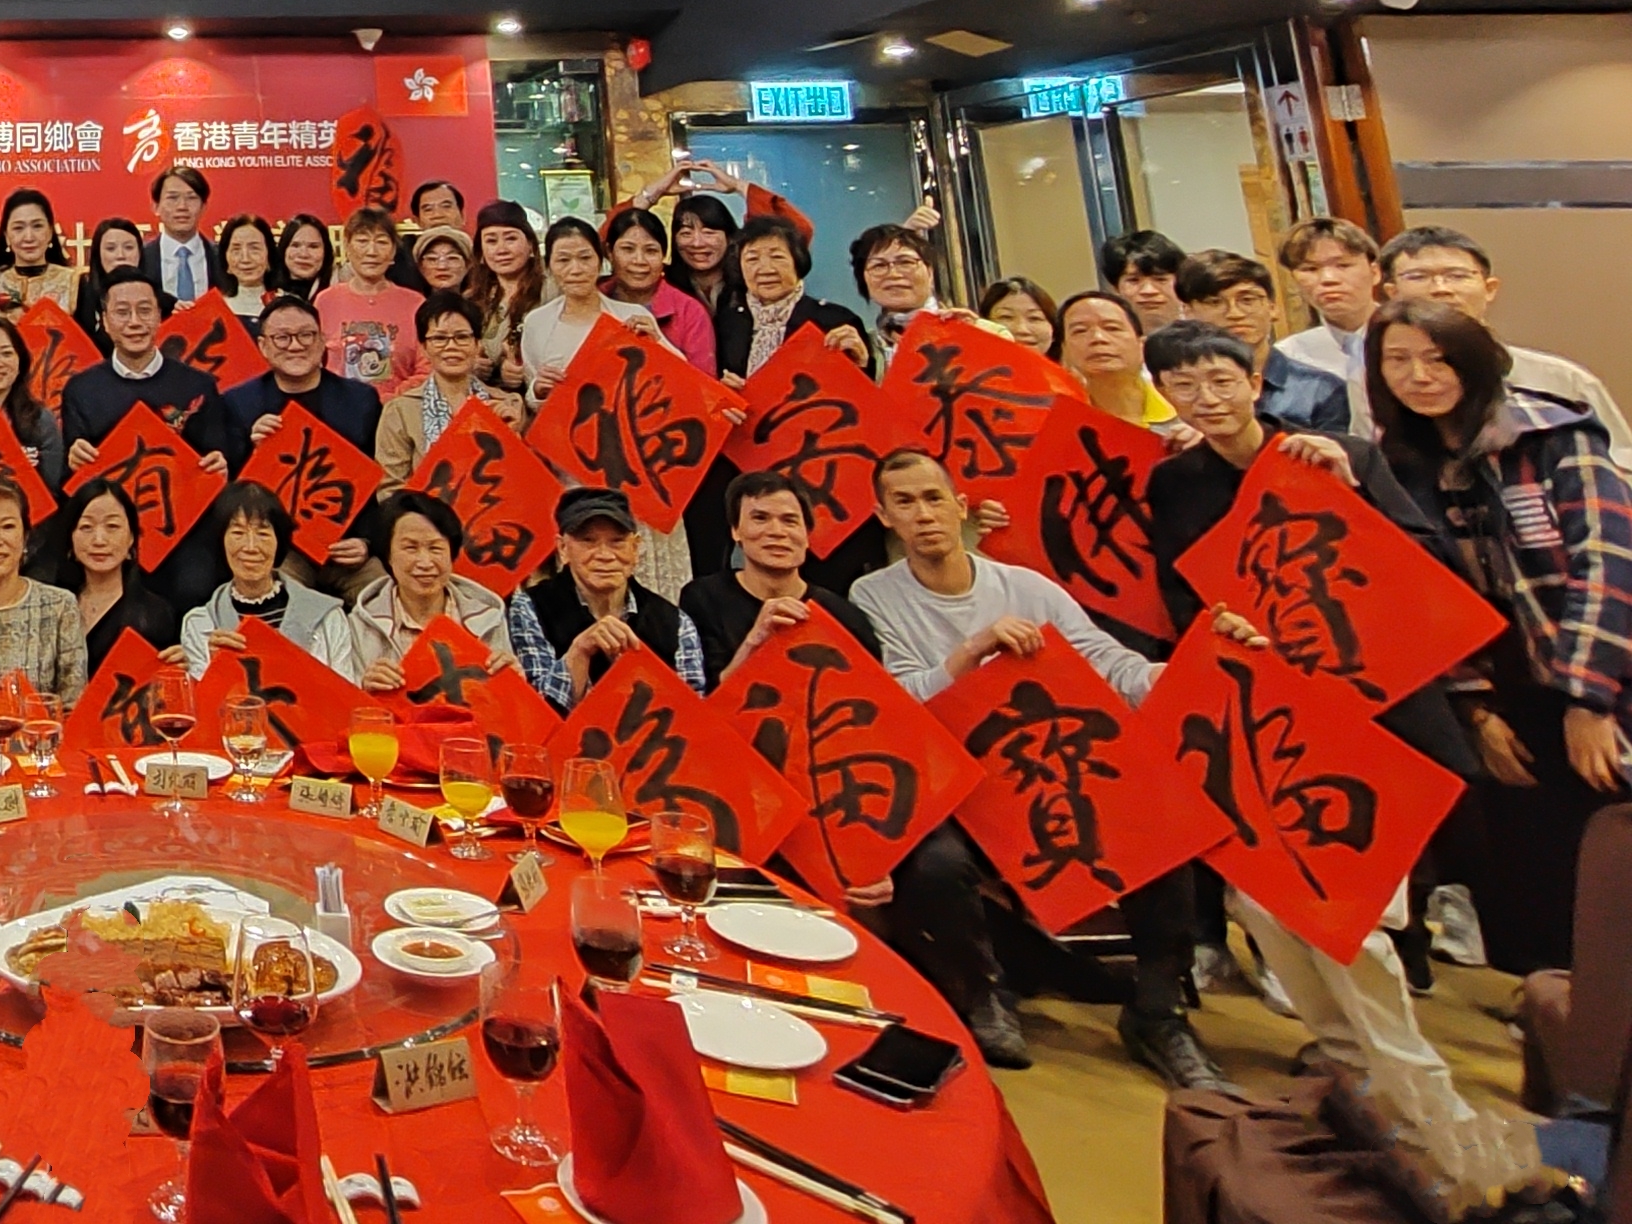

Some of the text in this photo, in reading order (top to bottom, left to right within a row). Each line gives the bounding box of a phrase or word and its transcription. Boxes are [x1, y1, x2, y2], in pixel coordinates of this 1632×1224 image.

[14, 158, 102, 174] ASSOCIATION
[173, 156, 204, 168] HONG
[205, 156, 236, 168] KONG
[237, 155, 273, 167] YOUTH
[274, 155, 303, 167] ELITE
[757, 87, 803, 117] EXIT
[806, 87, 846, 117] 出口
[100, 428, 178, 536] 有
[569, 346, 707, 508] 福
[754, 373, 878, 523] 安
[735, 643, 918, 890] 福
[967, 680, 1128, 894] 寶
[1173, 656, 1379, 903] 福
